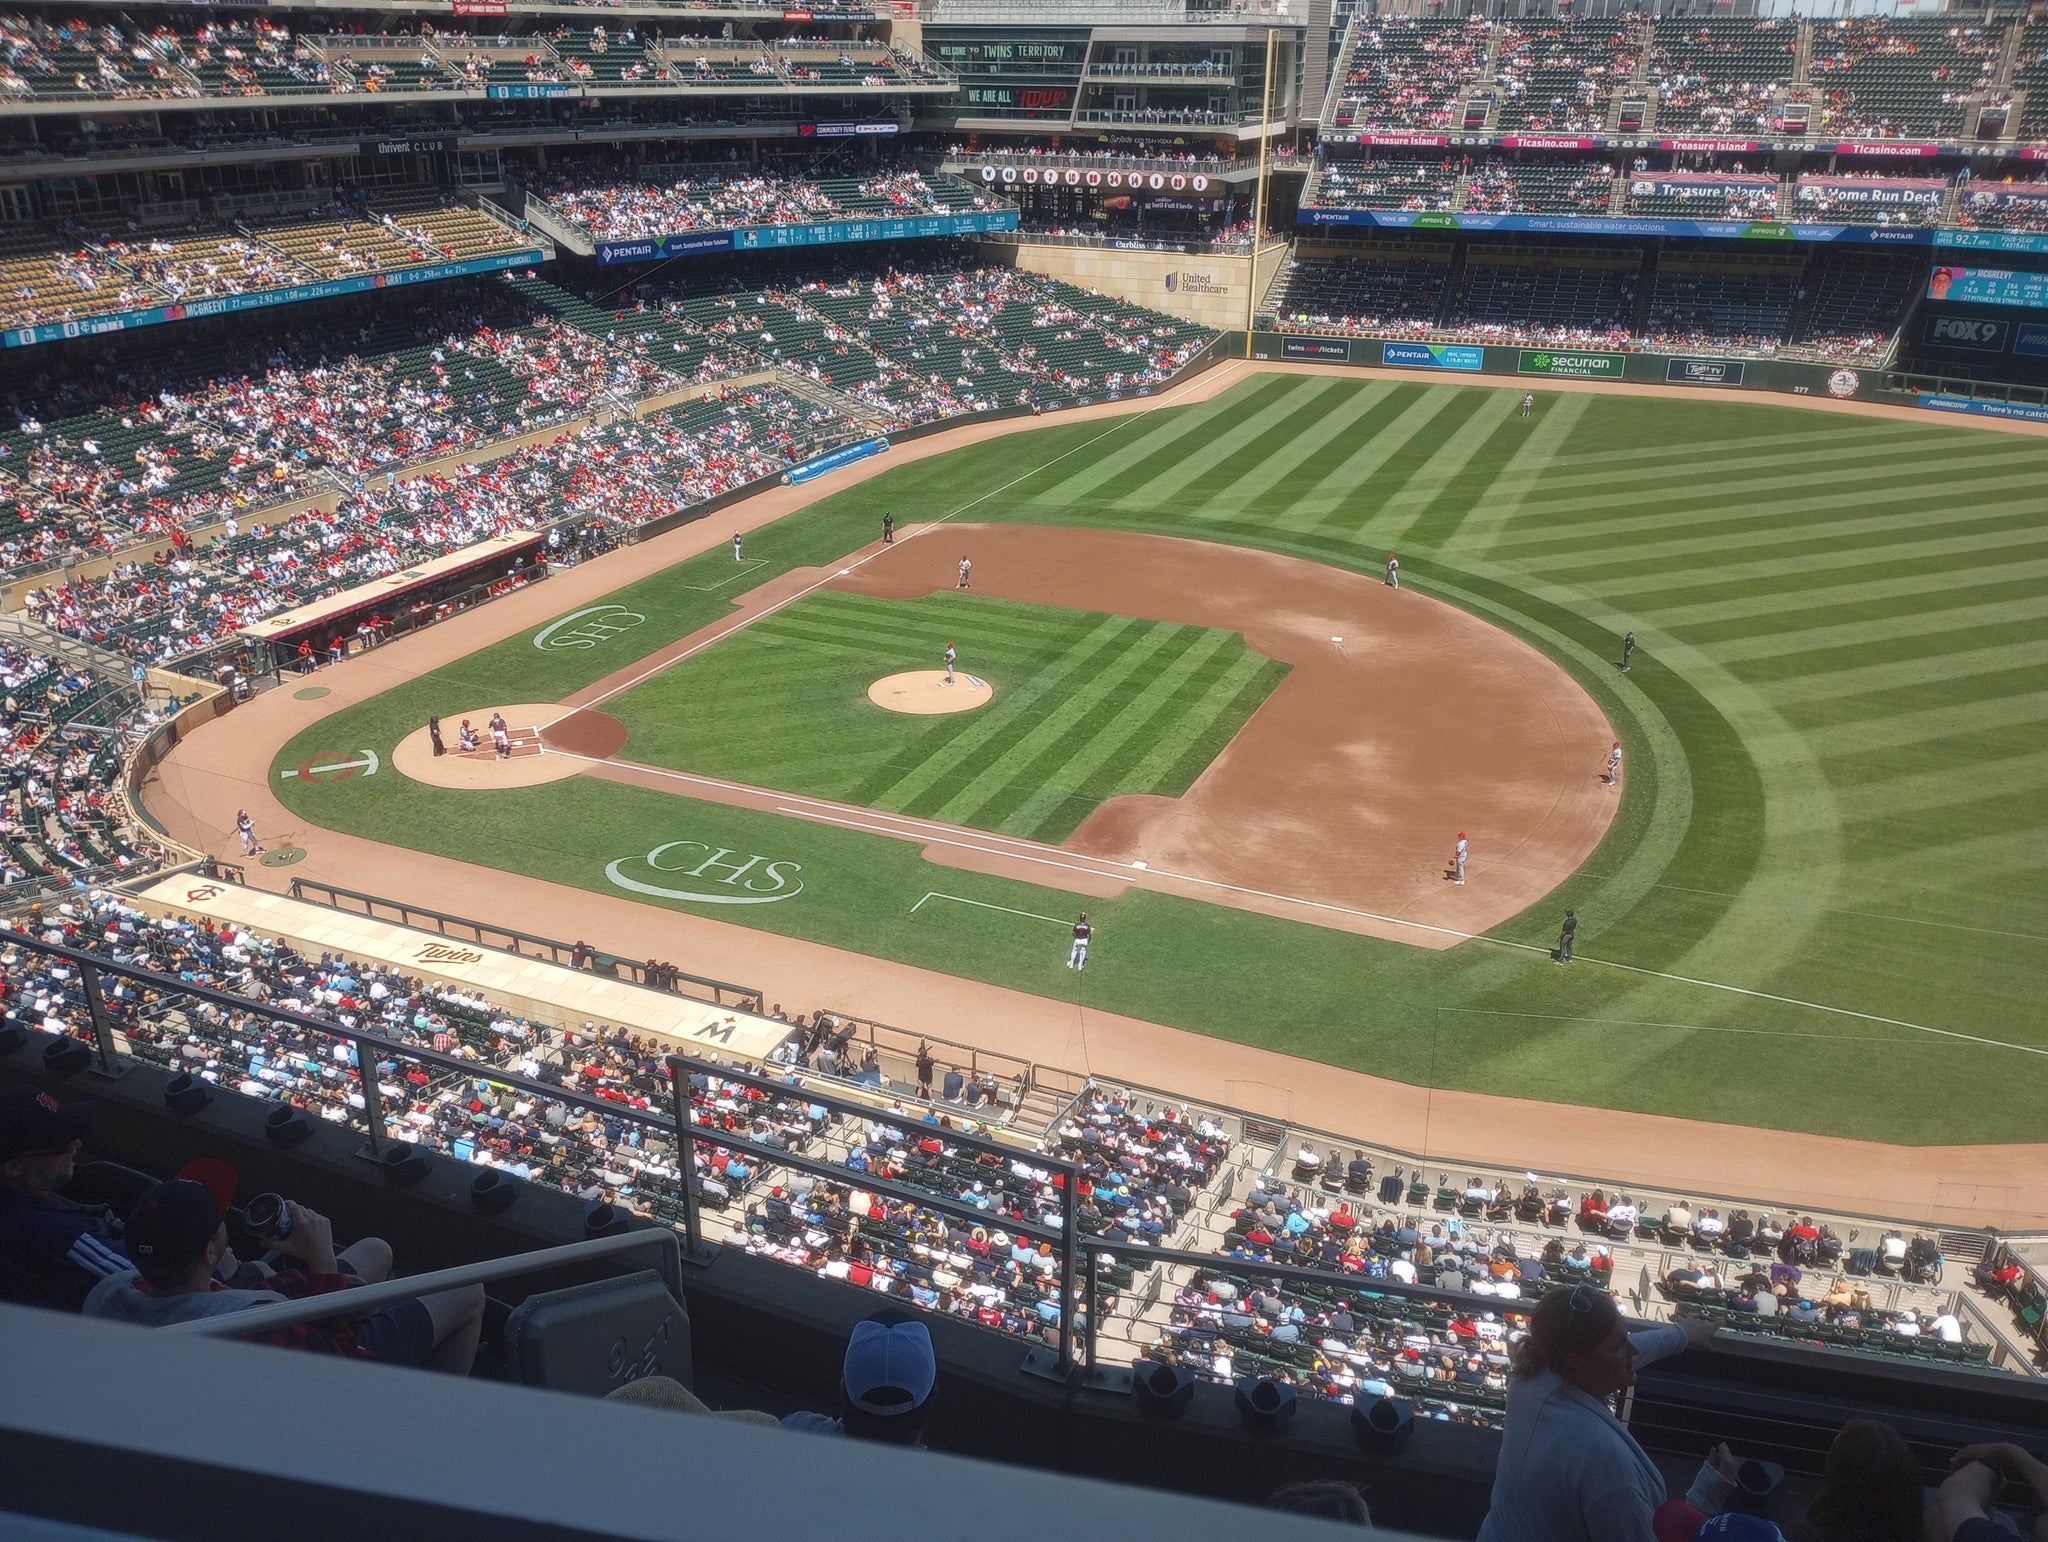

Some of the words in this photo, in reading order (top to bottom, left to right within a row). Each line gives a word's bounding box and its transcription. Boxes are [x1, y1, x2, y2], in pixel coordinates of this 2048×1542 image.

[485, 5, 505, 13] SECTION
[940, 46, 966, 56] WELCOME
[984, 46, 1013, 58] TWINS
[1018, 46, 1065, 57] TERRITORY
[968, 90, 981, 103] WE
[982, 90, 996, 103] ARE
[998, 90, 1012, 103] ALL
[1015, 88, 1068, 109] Twins
[1371, 136, 1409, 145] Treasure
[1411, 137, 1438, 145] Island
[1517, 138, 1578, 148] TIcasino.com
[1672, 141, 1715, 150] Treasure
[1716, 142, 1748, 151] Island
[378, 142, 410, 154] thrivent
[414, 141, 443, 152] CLUB
[1853, 145, 1921, 156] TIcasino.com
[986, 170, 992, 179] W
[1048, 173, 1053, 182] 7
[1828, 188, 1868, 202] Home
[1873, 190, 1899, 202] Run
[1903, 191, 1940, 203] Deck
[1528, 220, 1555, 229] Smart,
[1557, 221, 1602, 230] sustainable
[1628, 224, 1667, 232] solutions.
[1880, 232, 1914, 240] PENTAIR
[1956, 234, 1980, 245] 92.7
[1116, 241, 1146, 250] Carbliss
[614, 246, 652, 258] PENTAIR
[386, 274, 403, 286] GRAY
[409, 272, 420, 281] 0-0
[1182, 272, 1211, 284] United
[1977, 270, 2014, 280] MCGREEVY
[1182, 283, 1228, 294] Healthcare
[186, 302, 227, 316] MCGREEVY
[232, 300, 240, 308] 27
[259, 294, 273, 305] 2.92
[285, 290, 298, 300] 1.08
[311, 287, 324, 296] .226
[68, 323, 75, 335] 0
[1934, 319, 1981, 341] FOX
[1982, 324, 1997, 342] 9
[24, 330, 32, 343] 0
[1552, 357, 1610, 369] securian
[1793, 386, 1809, 394] 377
[1928, 400, 1969, 409] PROGRESSIVE
[1982, 404, 2012, 415] There's
[2026, 410, 2048, 419] catch
[550, 612, 646, 649] CHS
[646, 840, 802, 892] CHS
[412, 943, 484, 964] Twins
[692, 1022, 736, 1044] M
[1195, 1162, 1204, 1172] 15
